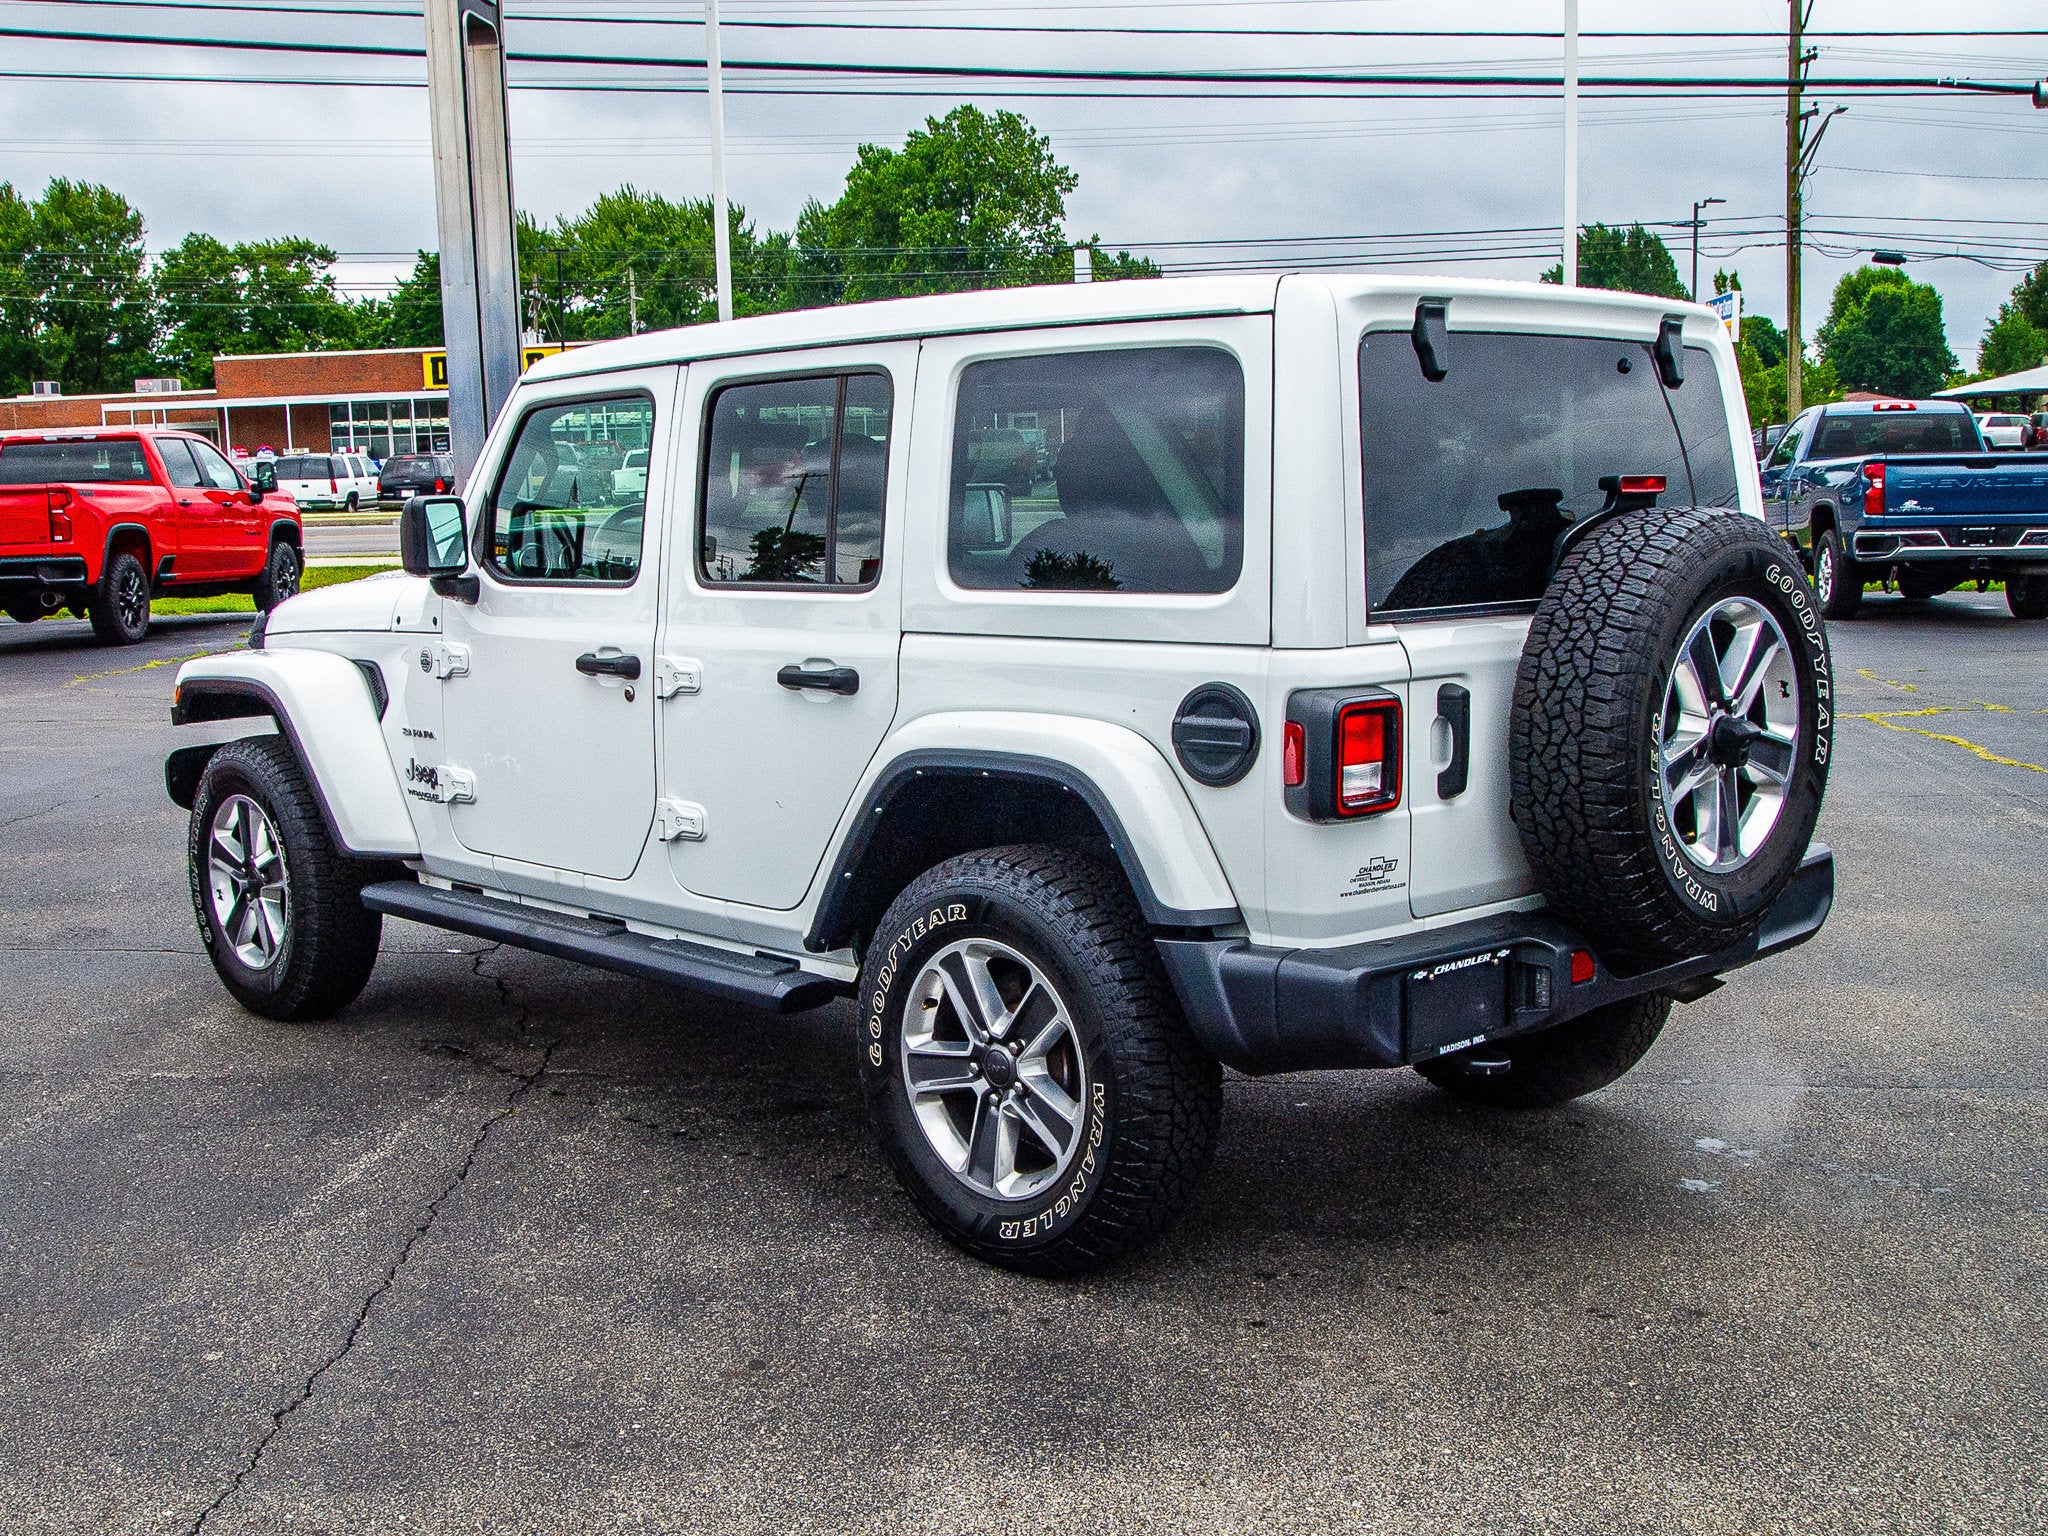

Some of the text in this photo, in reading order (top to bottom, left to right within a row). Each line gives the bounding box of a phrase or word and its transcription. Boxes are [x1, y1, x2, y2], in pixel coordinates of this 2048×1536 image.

[1898, 477, 2048, 488] CHEVROLE
[1765, 563, 1830, 766] GOODYEAR
[405, 757, 439, 790] Jeep
[1651, 712, 1718, 912] WRANGLER
[1358, 862, 1394, 874] CHANDLER
[869, 903, 968, 1067] GOODYEAR
[1433, 953, 1492, 975] CHANDLER
[999, 1082, 1105, 1239] WRANGLER
